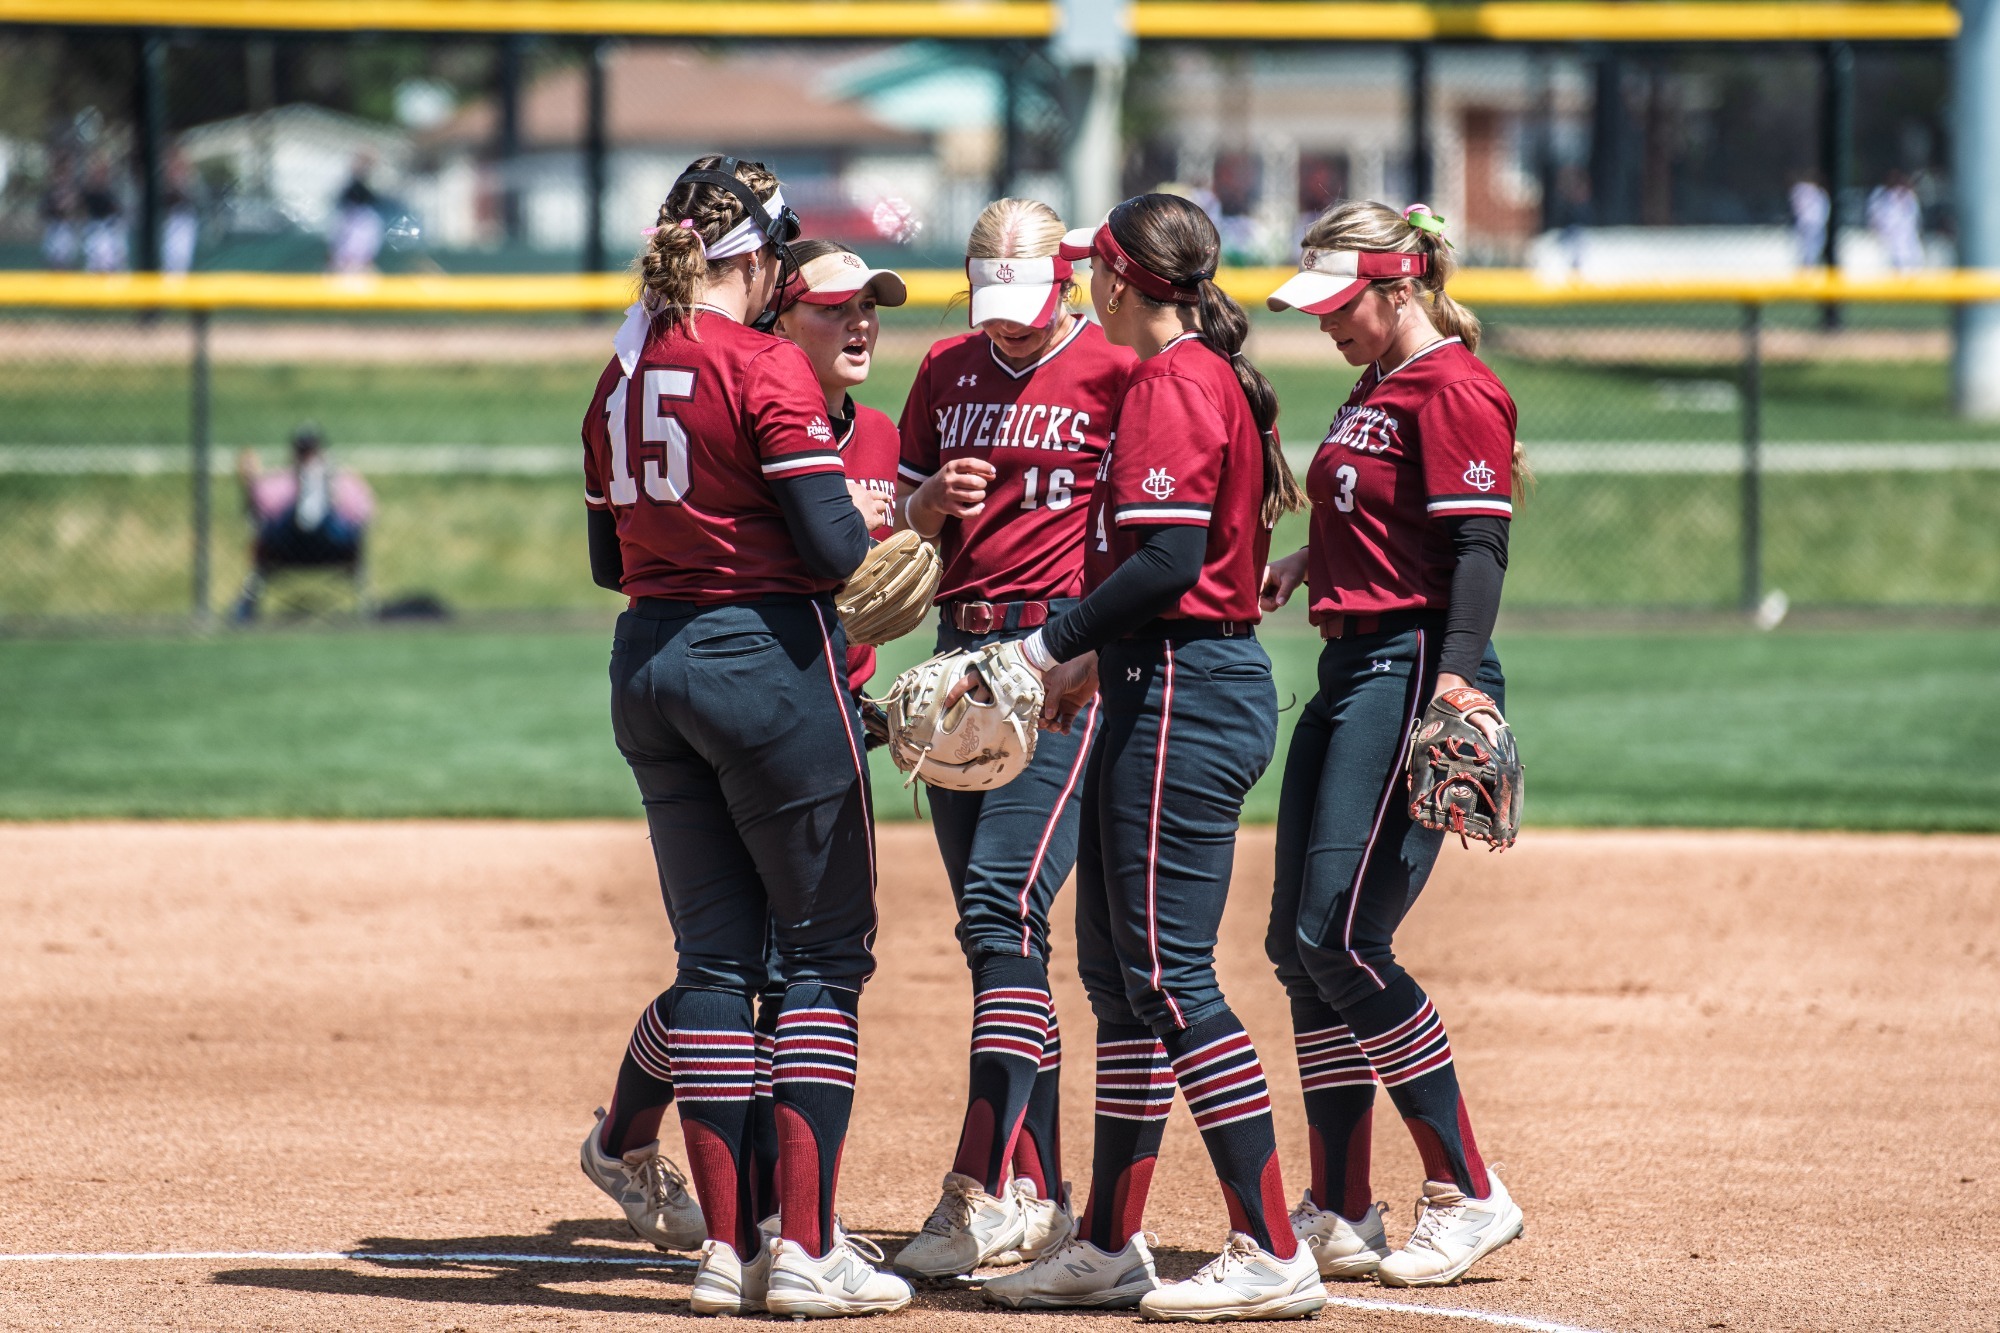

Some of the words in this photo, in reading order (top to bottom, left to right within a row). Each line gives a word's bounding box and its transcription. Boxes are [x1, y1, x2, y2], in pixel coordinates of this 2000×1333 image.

[604, 368, 697, 506] 15
[1020, 466, 1075, 511] 16
[1334, 464, 1358, 513] 3
